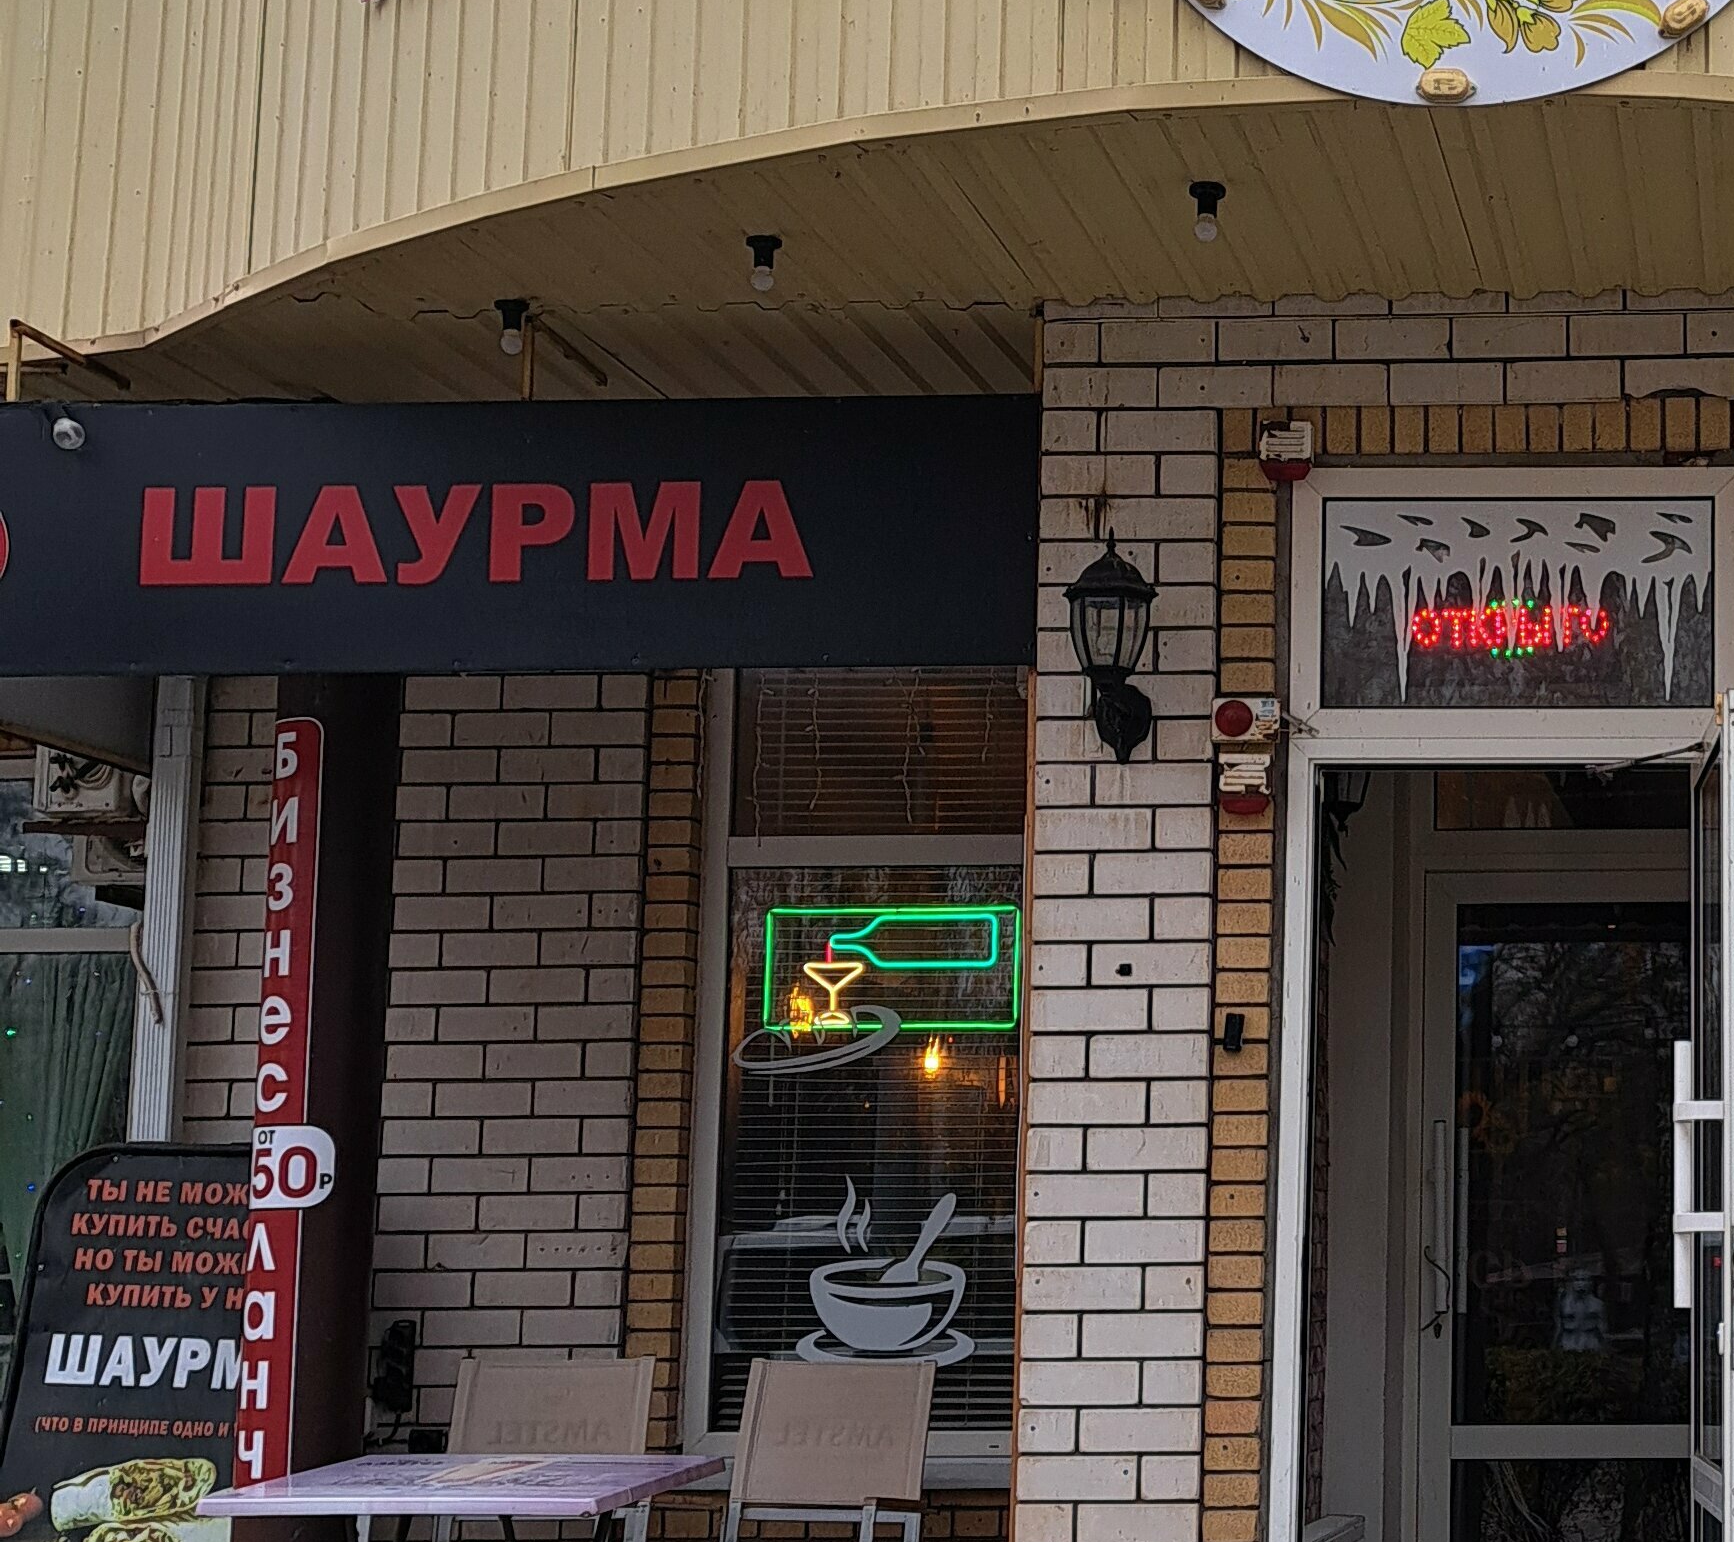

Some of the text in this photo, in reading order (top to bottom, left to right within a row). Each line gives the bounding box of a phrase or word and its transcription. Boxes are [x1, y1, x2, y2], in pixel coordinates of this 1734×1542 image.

[139, 479, 814, 586] ШАУРМА
[87, 1179, 249, 1205] ТЫ НЕ МОЖ
[71, 1213, 178, 1237] КУПИТЬ
[74, 1247, 246, 1275] НО ТЫ МОЖ
[86, 1283, 193, 1308] КУПИТЬ
[200, 1286, 219, 1309] У
[44, 1333, 243, 1390] ШАУРМ
[35, 1416, 69, 1433] (ЧТО
[73, 1417, 83, 1432] В
[87, 1417, 168, 1437] ПРИНЦИПЕ
[173, 1420, 213, 1438] ОДНО
[218, 1422, 229, 1438] И
